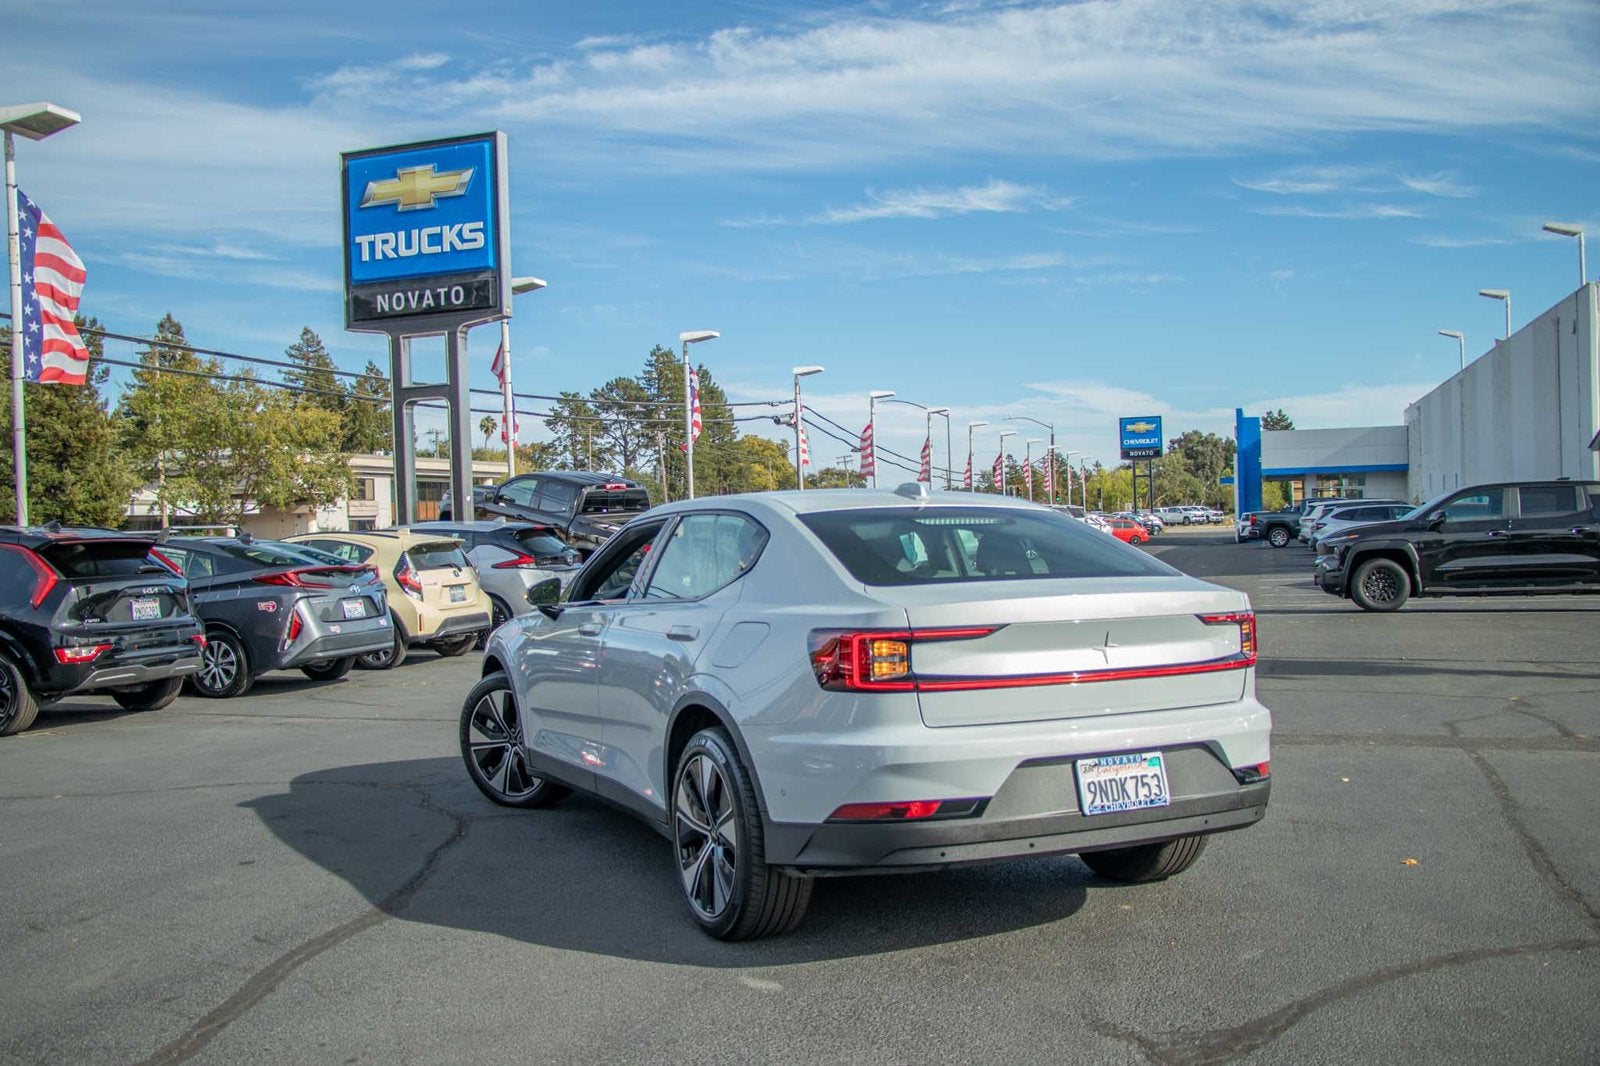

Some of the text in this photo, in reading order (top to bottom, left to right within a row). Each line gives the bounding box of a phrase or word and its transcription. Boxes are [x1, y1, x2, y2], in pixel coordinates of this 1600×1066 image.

[355, 221, 485, 261] TRUCKS
[376, 285, 465, 313] NOVATO
[1100, 755, 1142, 767] NOVATO
[1087, 773, 1162, 807] 9NDK753
[1104, 799, 1151, 811] CHEVROLET
